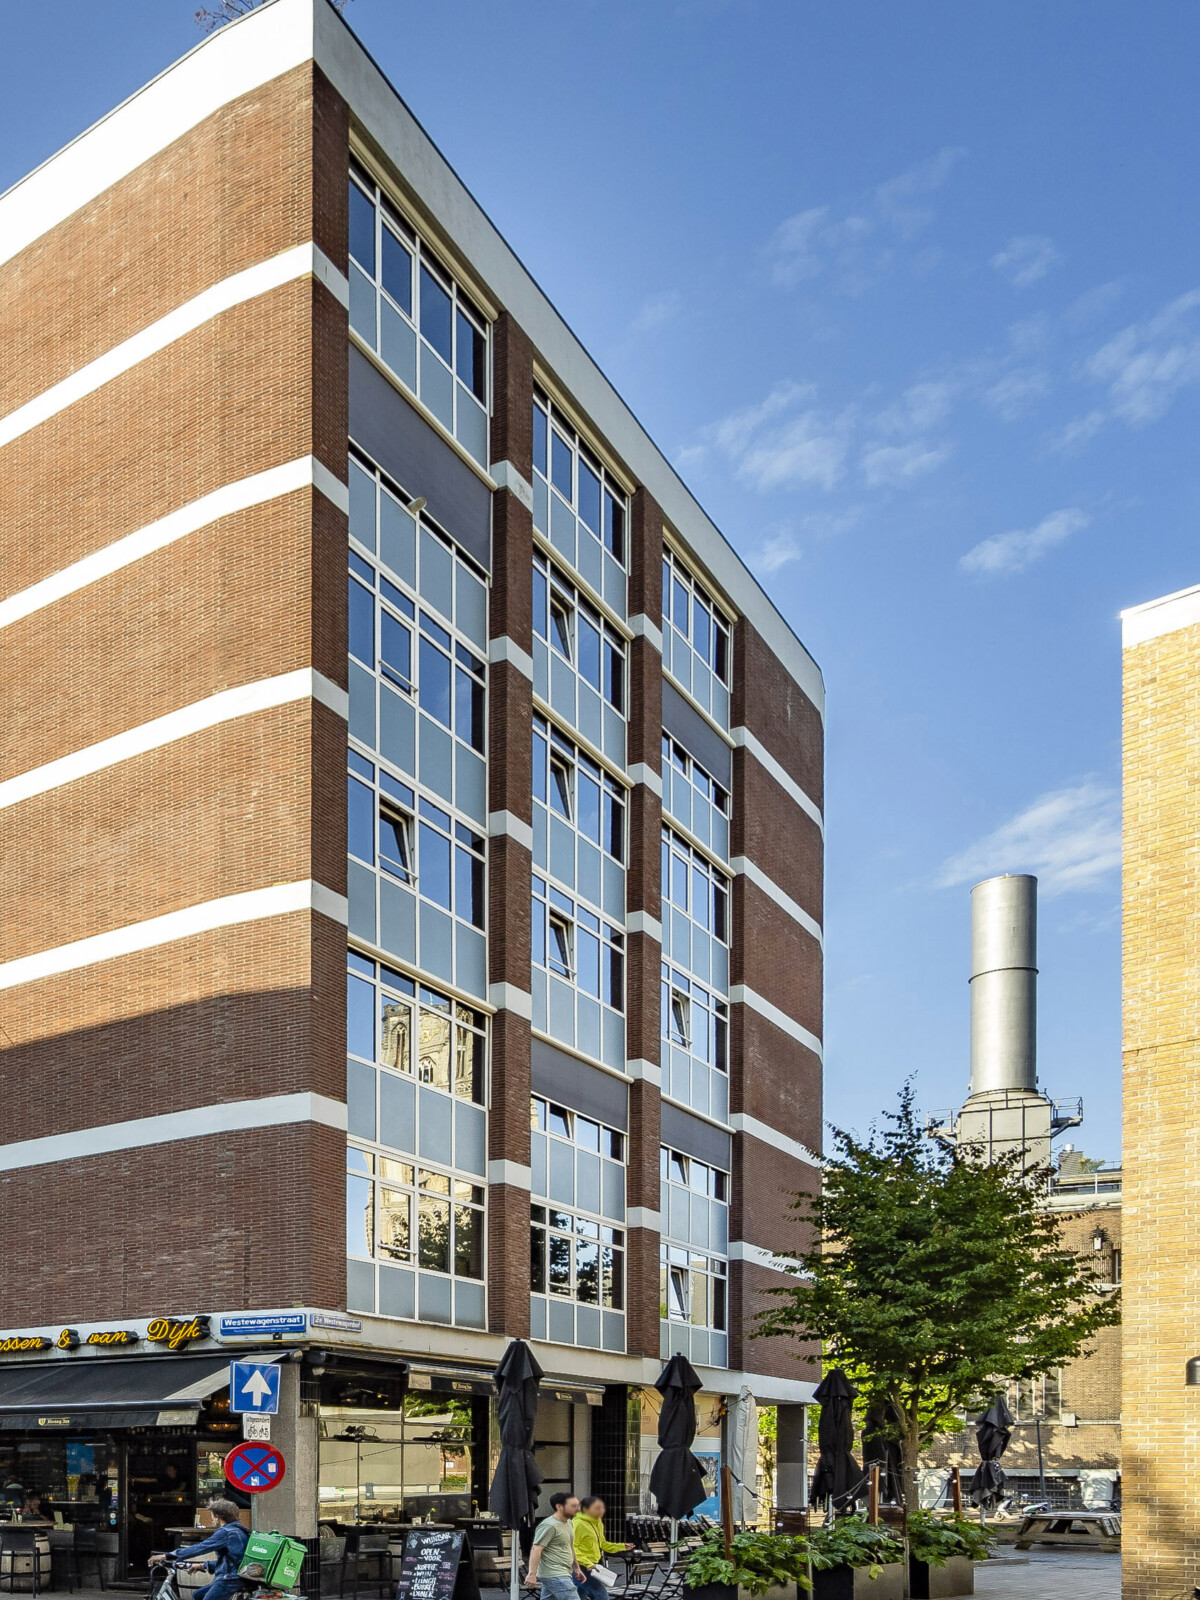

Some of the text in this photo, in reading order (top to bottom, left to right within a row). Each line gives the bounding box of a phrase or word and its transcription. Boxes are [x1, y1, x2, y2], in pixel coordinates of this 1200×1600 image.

[224, 1316, 301, 1327] Westewagenstraat
[323, 1319, 361, 1329] Westewagenhof
[57, 1329, 70, 1348] &
[88, 1331, 128, 1344] van
[147, 1318, 201, 1349] Dijk
[420, 1548, 440, 1556] OPEN
